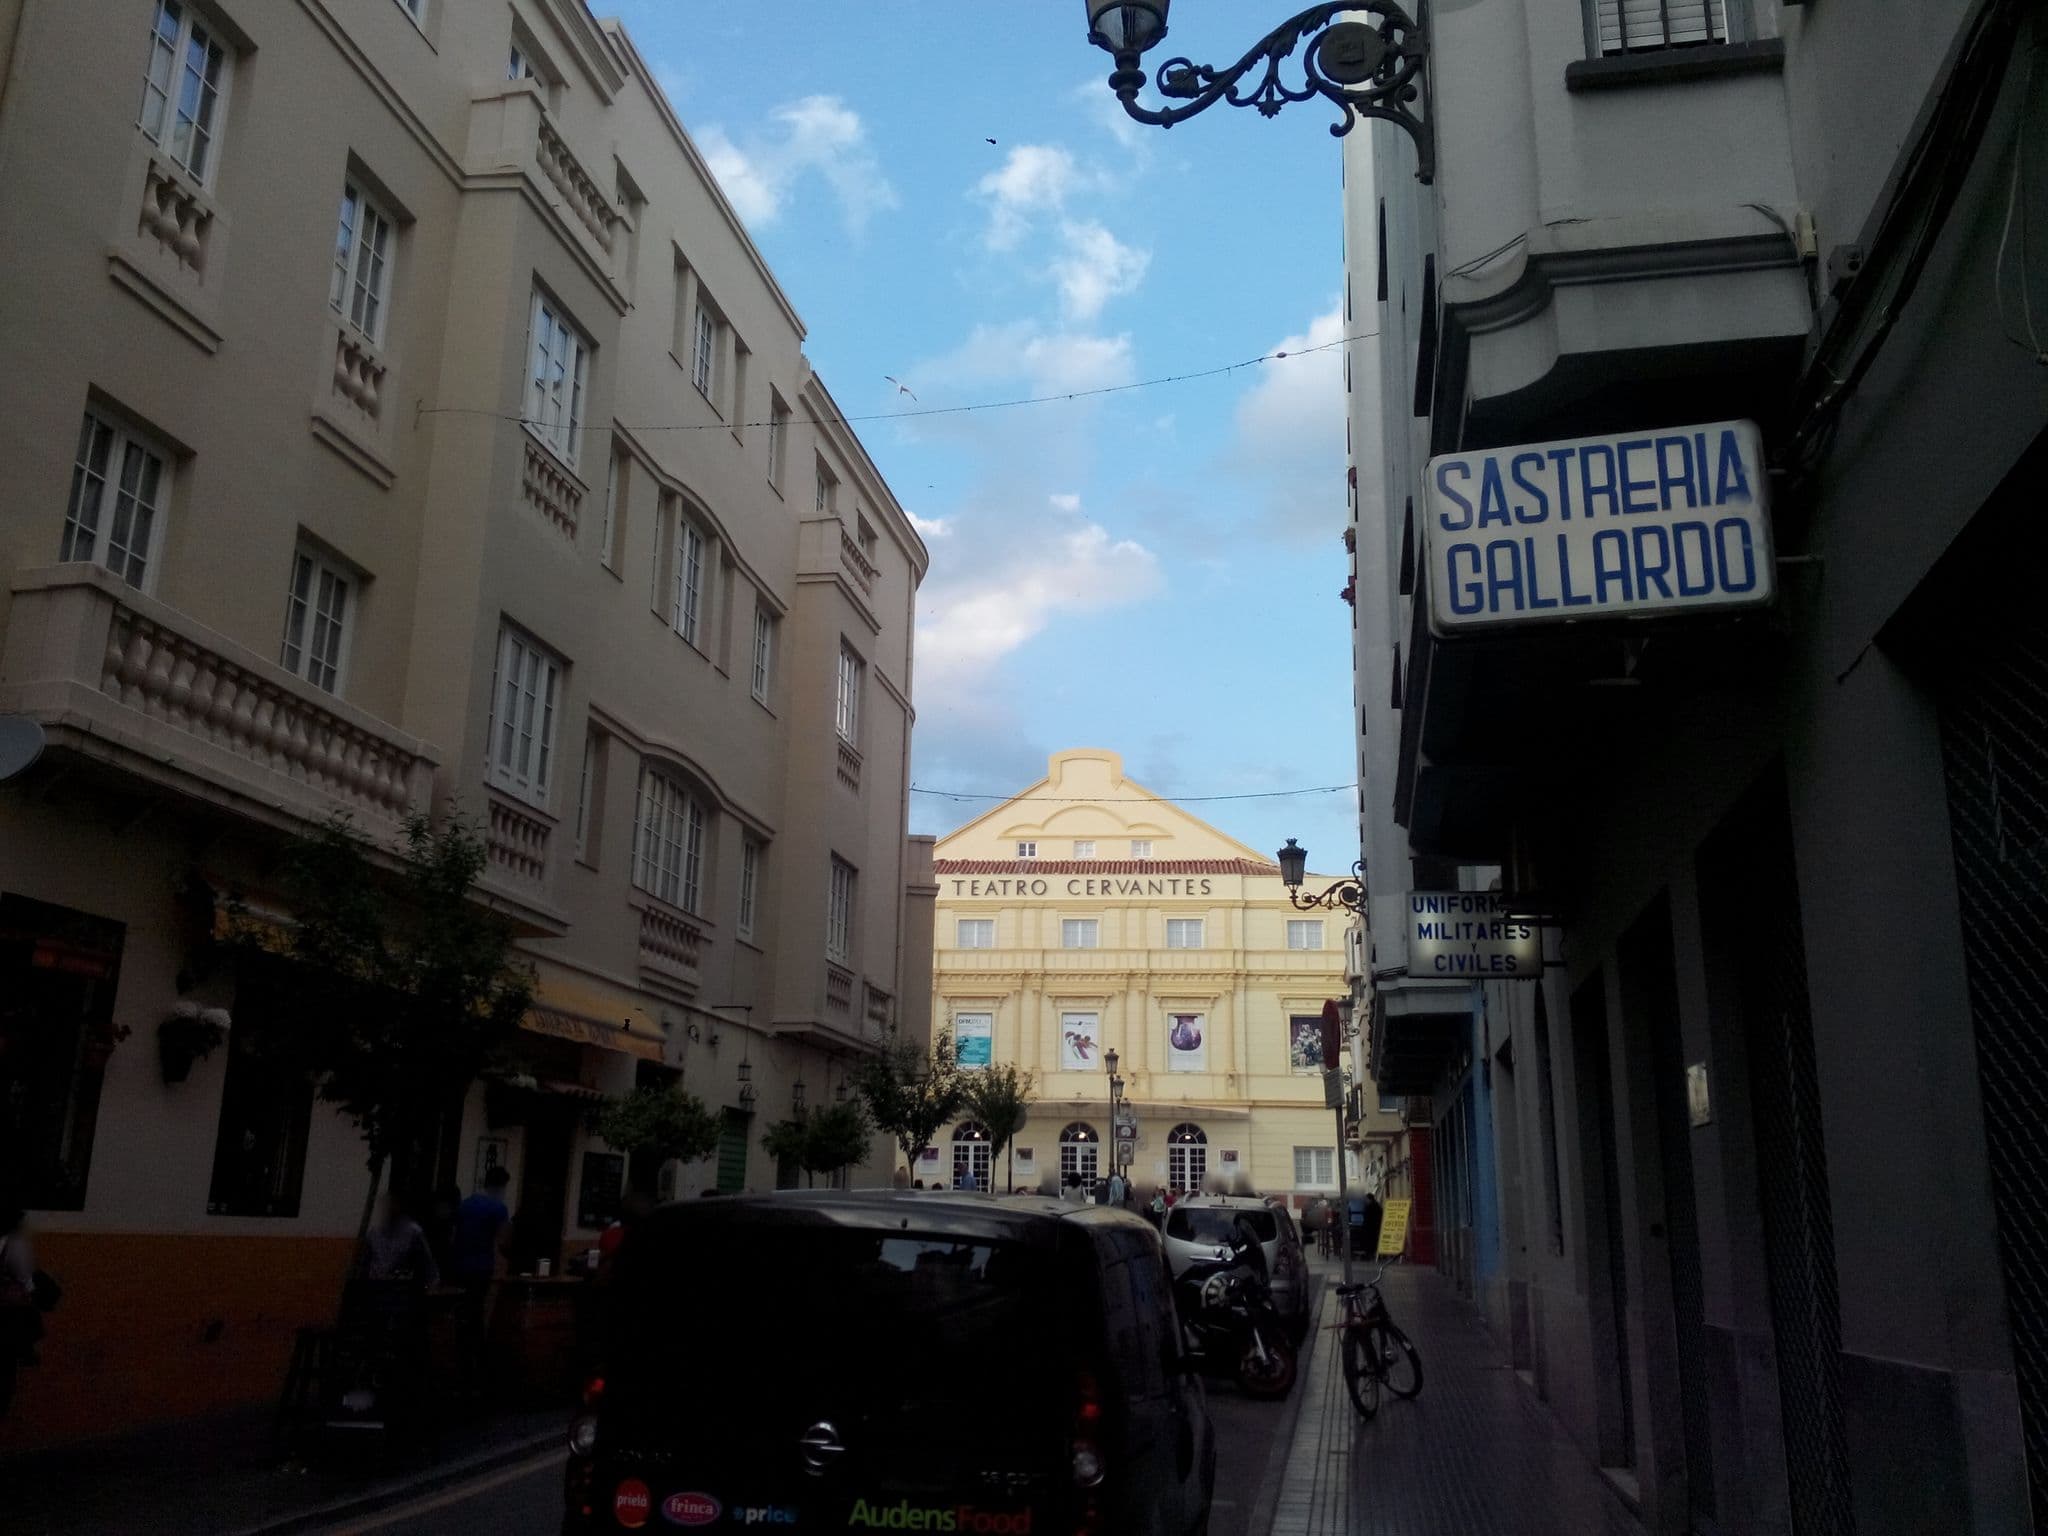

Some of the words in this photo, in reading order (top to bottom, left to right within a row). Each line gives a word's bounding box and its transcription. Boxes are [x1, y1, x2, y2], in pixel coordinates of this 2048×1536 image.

[1437, 430, 1752, 532] SASTRERIA
[1446, 517, 1757, 616] GALLARDO
[952, 879, 1048, 896] TEATRO
[1067, 878, 1212, 895] CERVANTES
[1418, 922, 1531, 940] MILITARES
[1471, 943, 1477, 953] Y
[1434, 954, 1518, 972] CIVILES
[671, 1497, 714, 1515] frinca
